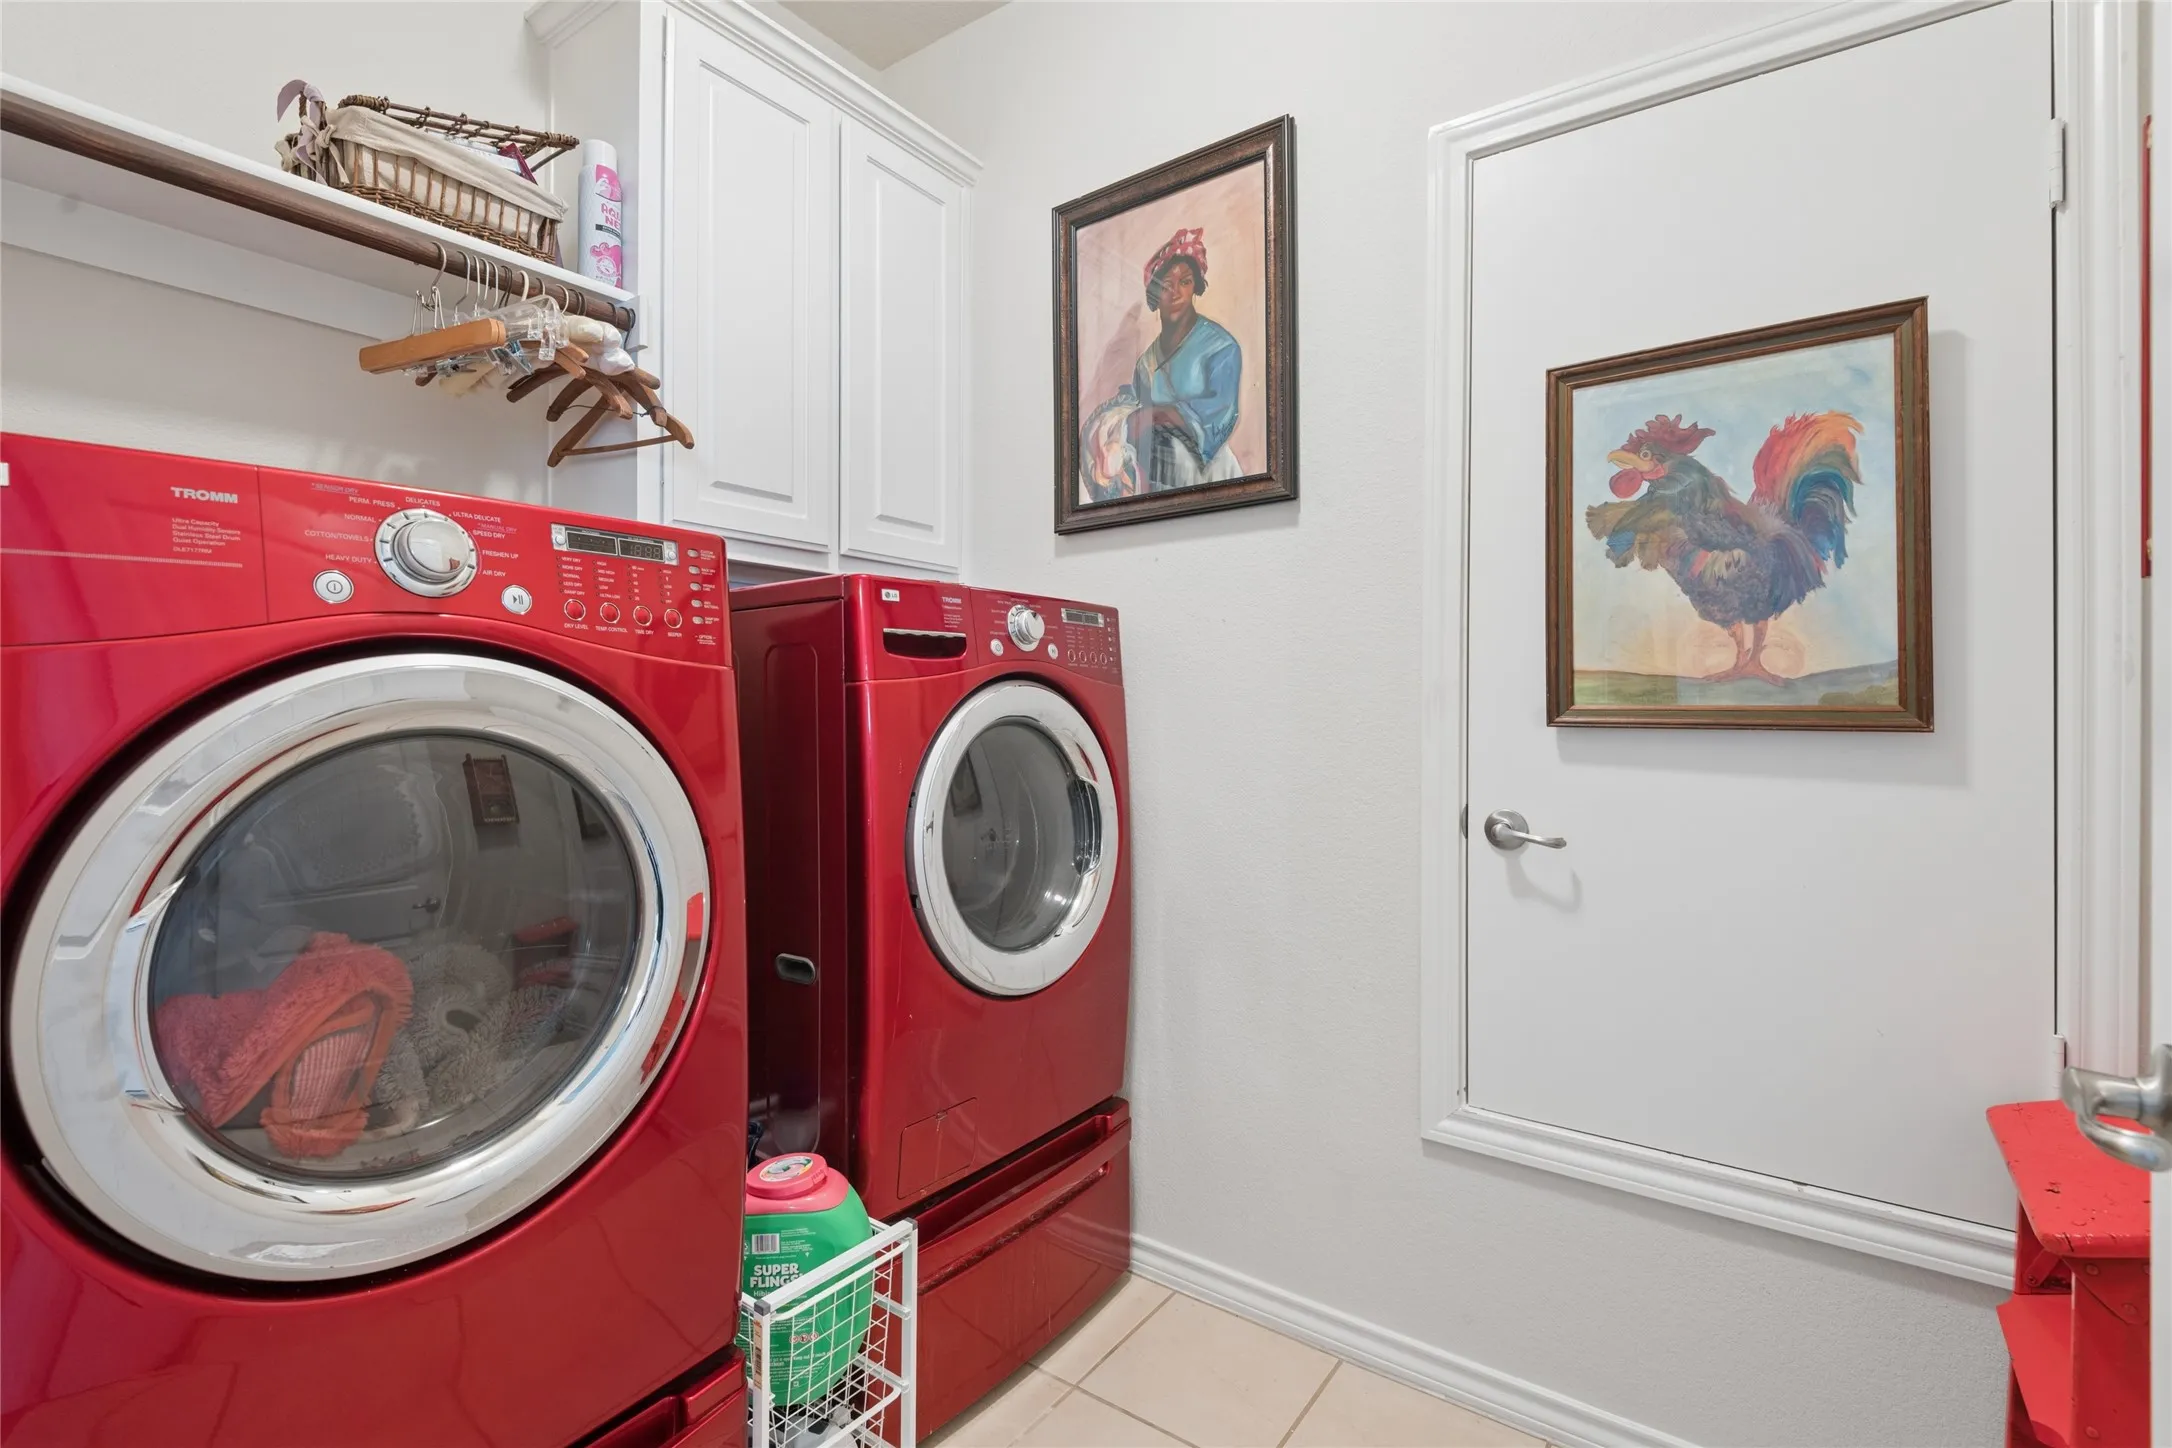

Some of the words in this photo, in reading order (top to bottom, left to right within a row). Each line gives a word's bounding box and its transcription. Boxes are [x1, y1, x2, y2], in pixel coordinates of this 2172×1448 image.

[605, 215, 620, 229] NE
[170, 486, 238, 504] TROMM
[372, 499, 395, 508] PRESS
[405, 496, 440, 507] DELICATES
[344, 513, 376, 523] NORMAL
[452, 511, 473, 519] ULTRA
[474, 514, 501, 523] DELICATE
[190, 519, 219, 527] Capacity
[172, 530, 203, 538] Stainless
[304, 530, 369, 542] COTTON/TOWELS
[472, 530, 492, 538] SPEED
[193, 538, 226, 546] Operation
[325, 554, 350, 562] HEAVY
[482, 550, 510, 558] FRESHEN
[754, 1263, 799, 1276] SUPER
